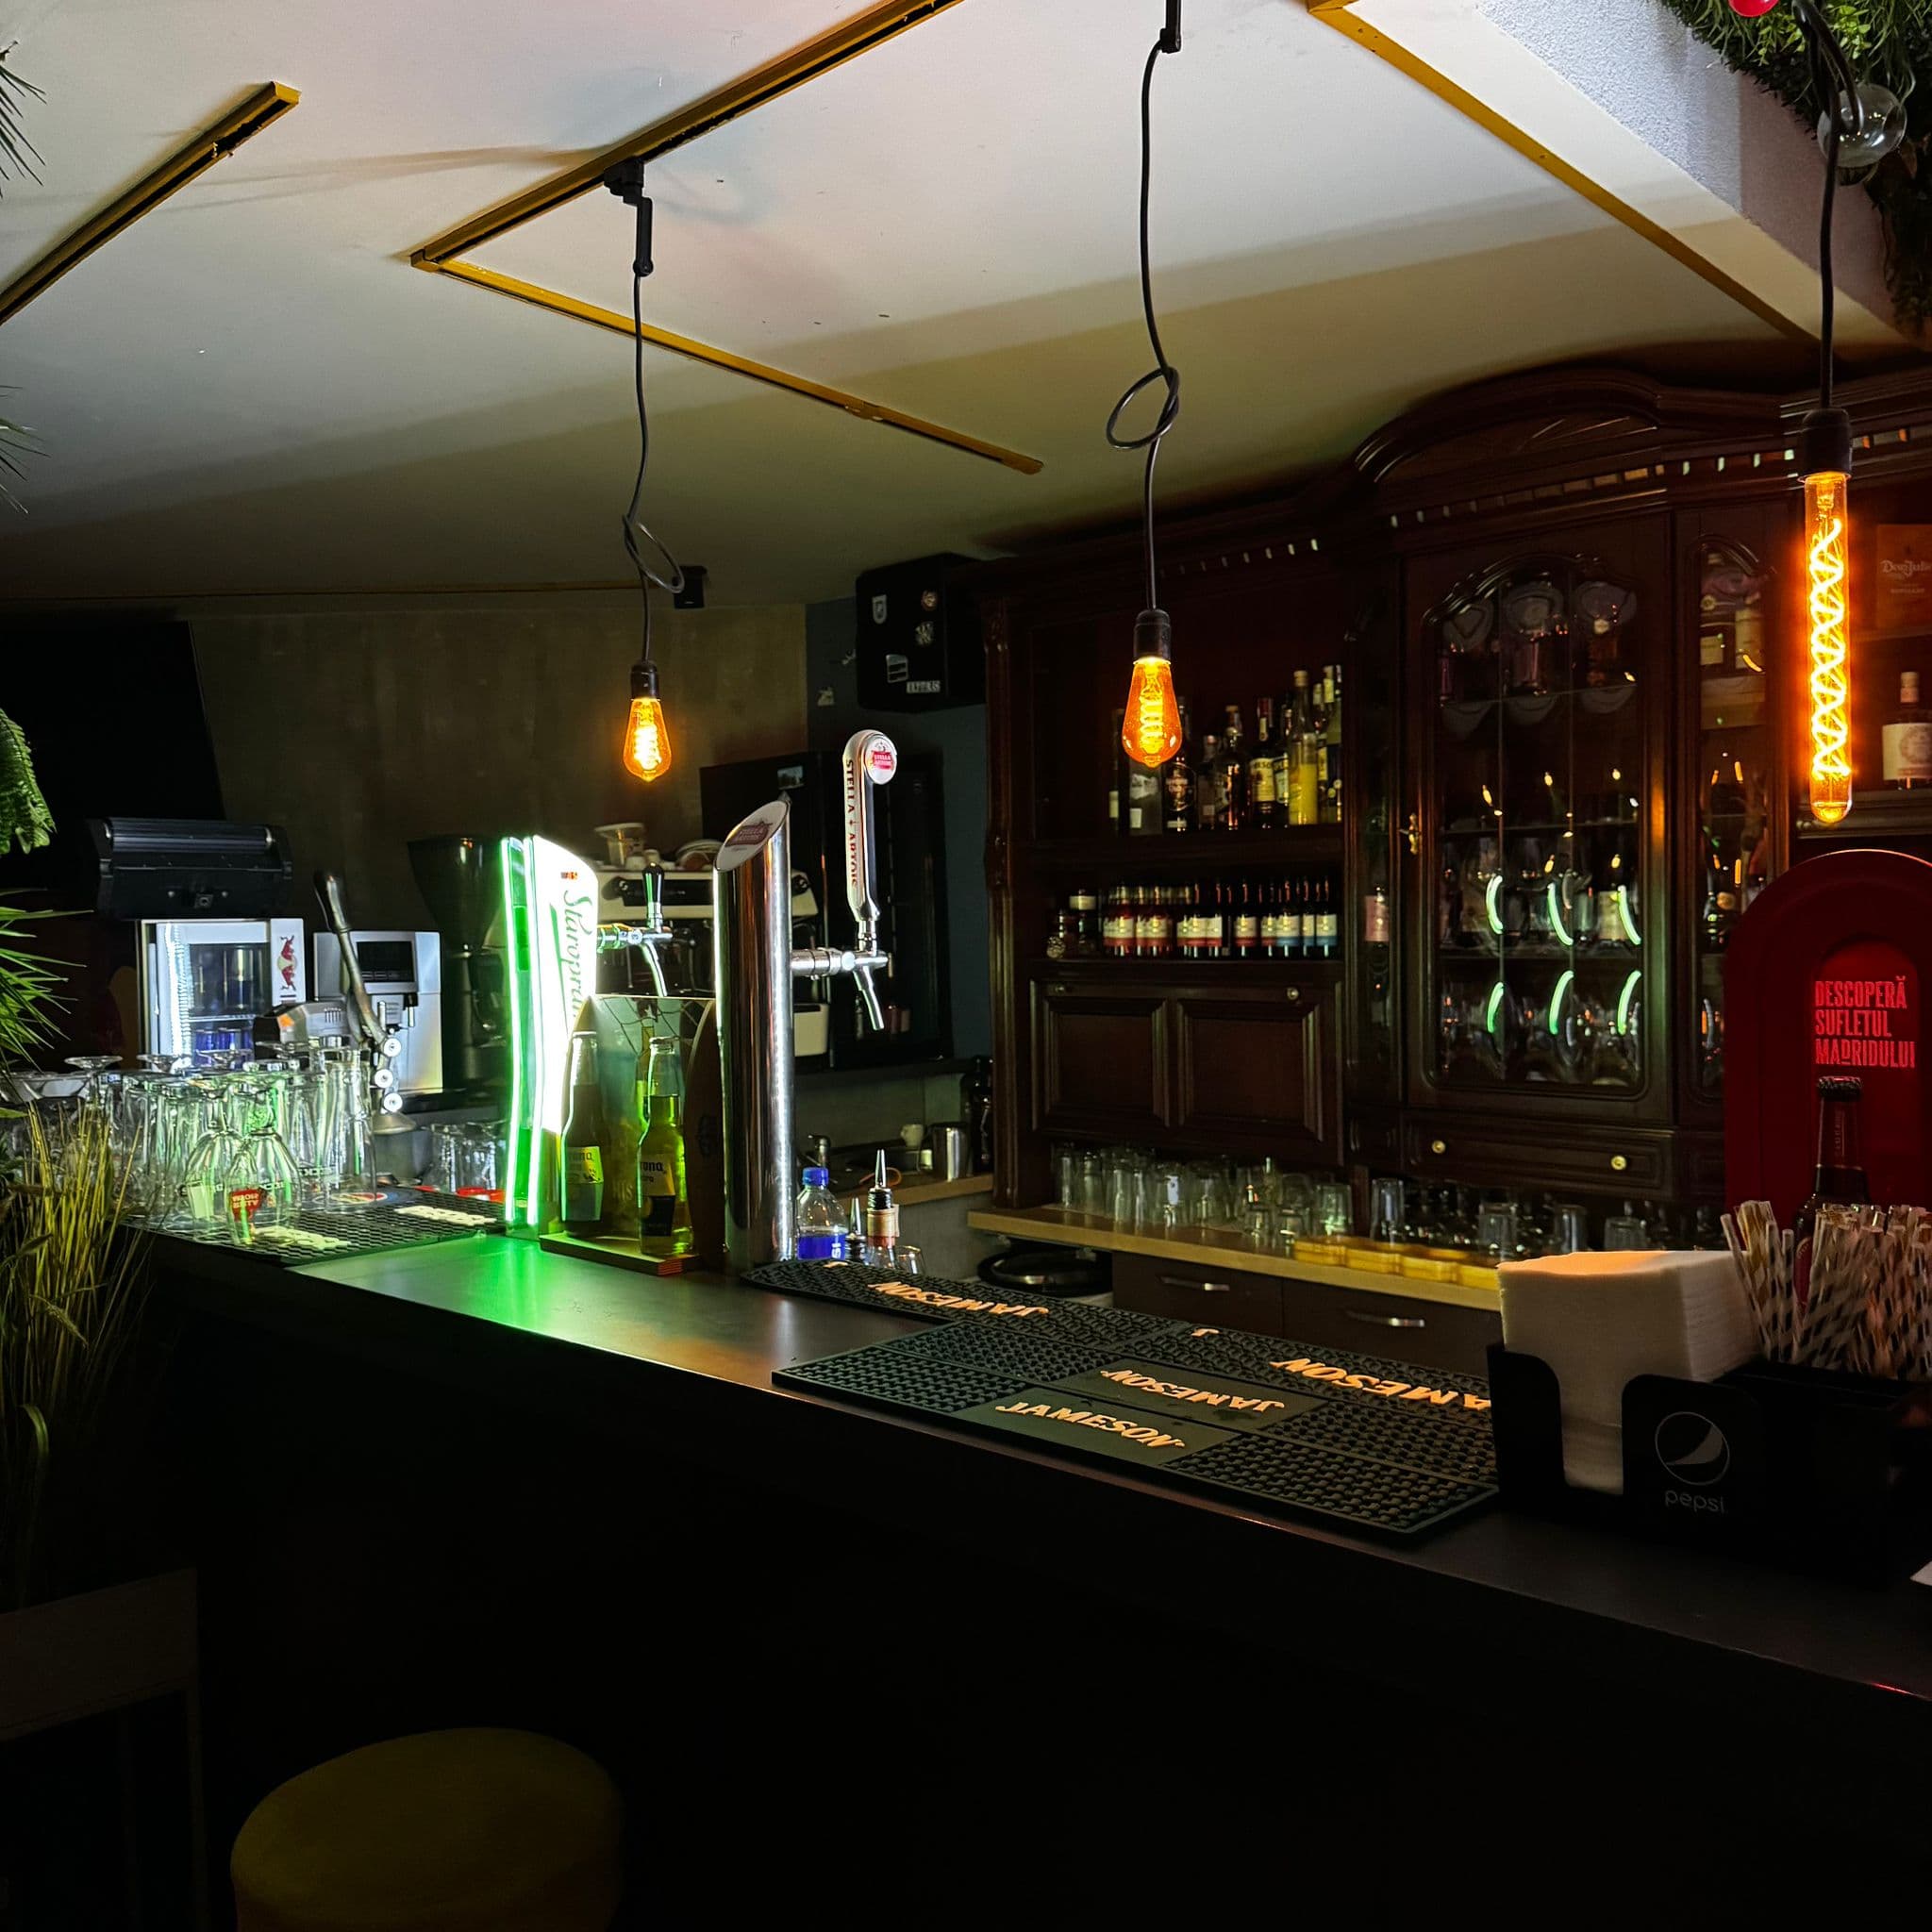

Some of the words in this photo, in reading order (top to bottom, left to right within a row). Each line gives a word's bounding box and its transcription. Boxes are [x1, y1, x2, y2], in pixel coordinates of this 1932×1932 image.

[846, 758, 855, 812] STELLA
[563, 890, 593, 1018] Staropra
[1814, 974, 1907, 1009] DESCOPERĂ
[1814, 1008, 1892, 1038] SUFLETUL
[1815, 1038, 1917, 1069] MADRIDULUI
[867, 1281, 1050, 1317] JAMESON
[1100, 1369, 1285, 1413] JAMESON
[1269, 1357, 1492, 1411] AMESON
[995, 1401, 1186, 1449] JAMESON
[1664, 1490, 1725, 1515] pepsi
